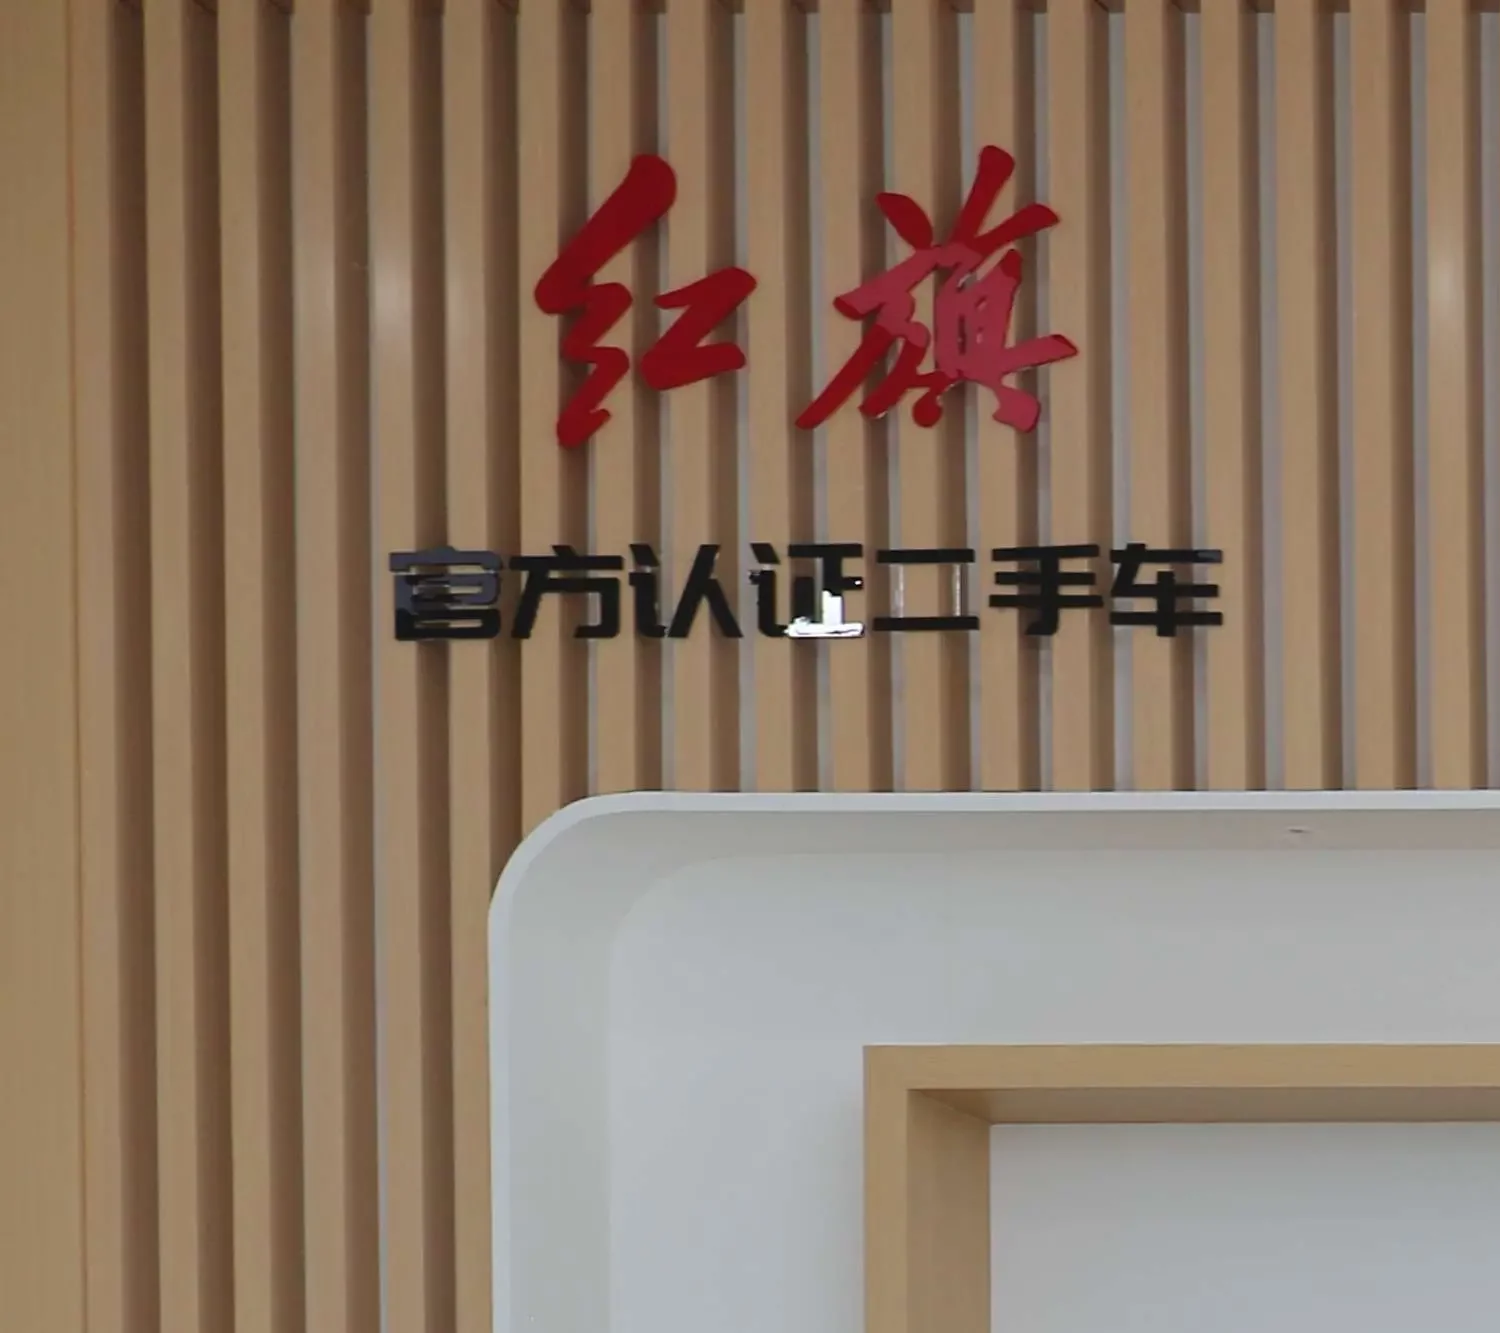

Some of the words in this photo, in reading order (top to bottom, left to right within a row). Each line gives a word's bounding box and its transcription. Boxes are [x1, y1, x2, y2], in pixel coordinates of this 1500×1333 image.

[533, 144, 1079, 450] 红旗
[389, 542, 1224, 641] 官方认证二手车
